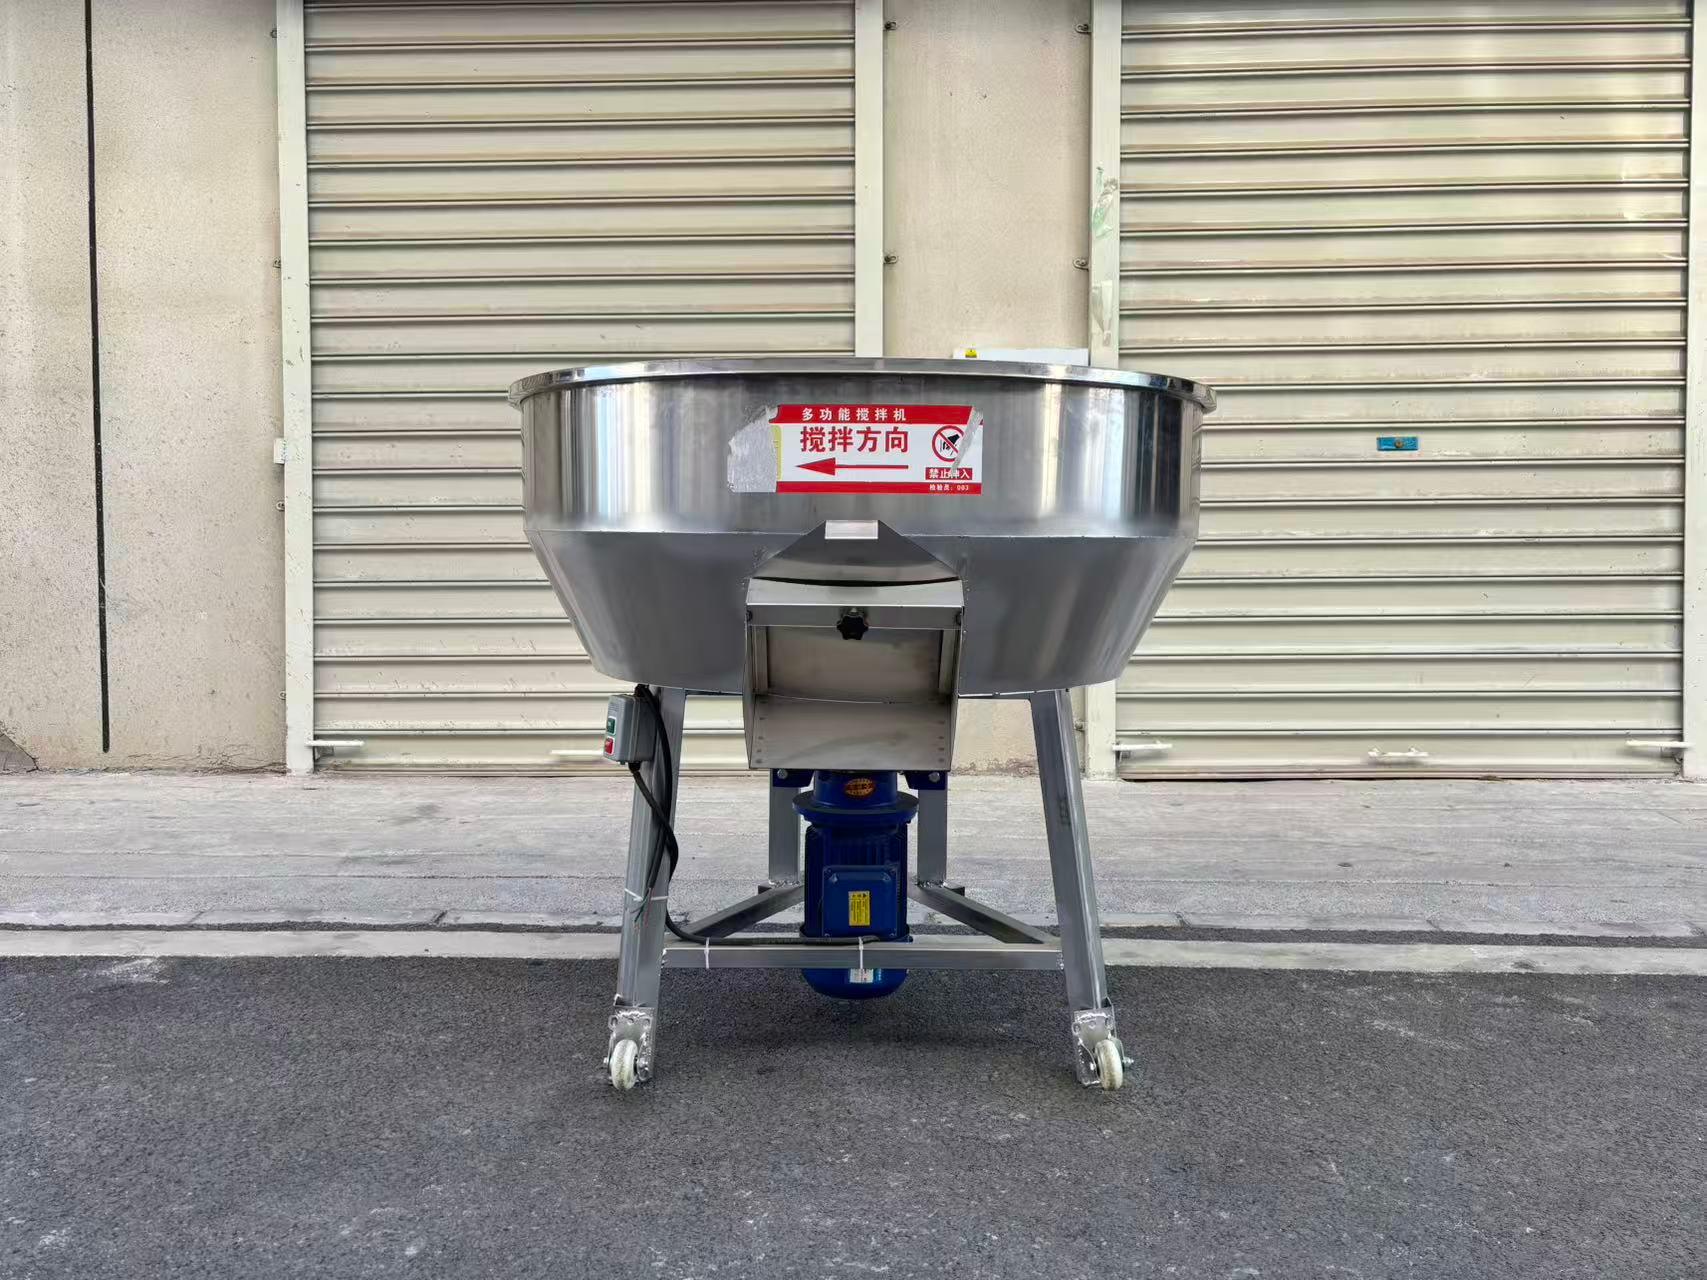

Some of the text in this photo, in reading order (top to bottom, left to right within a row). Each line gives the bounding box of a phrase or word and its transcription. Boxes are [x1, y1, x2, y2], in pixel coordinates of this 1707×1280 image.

[802, 407, 907, 421] 多功能搅拌机
[800, 426, 908, 452] 搅拌方向
